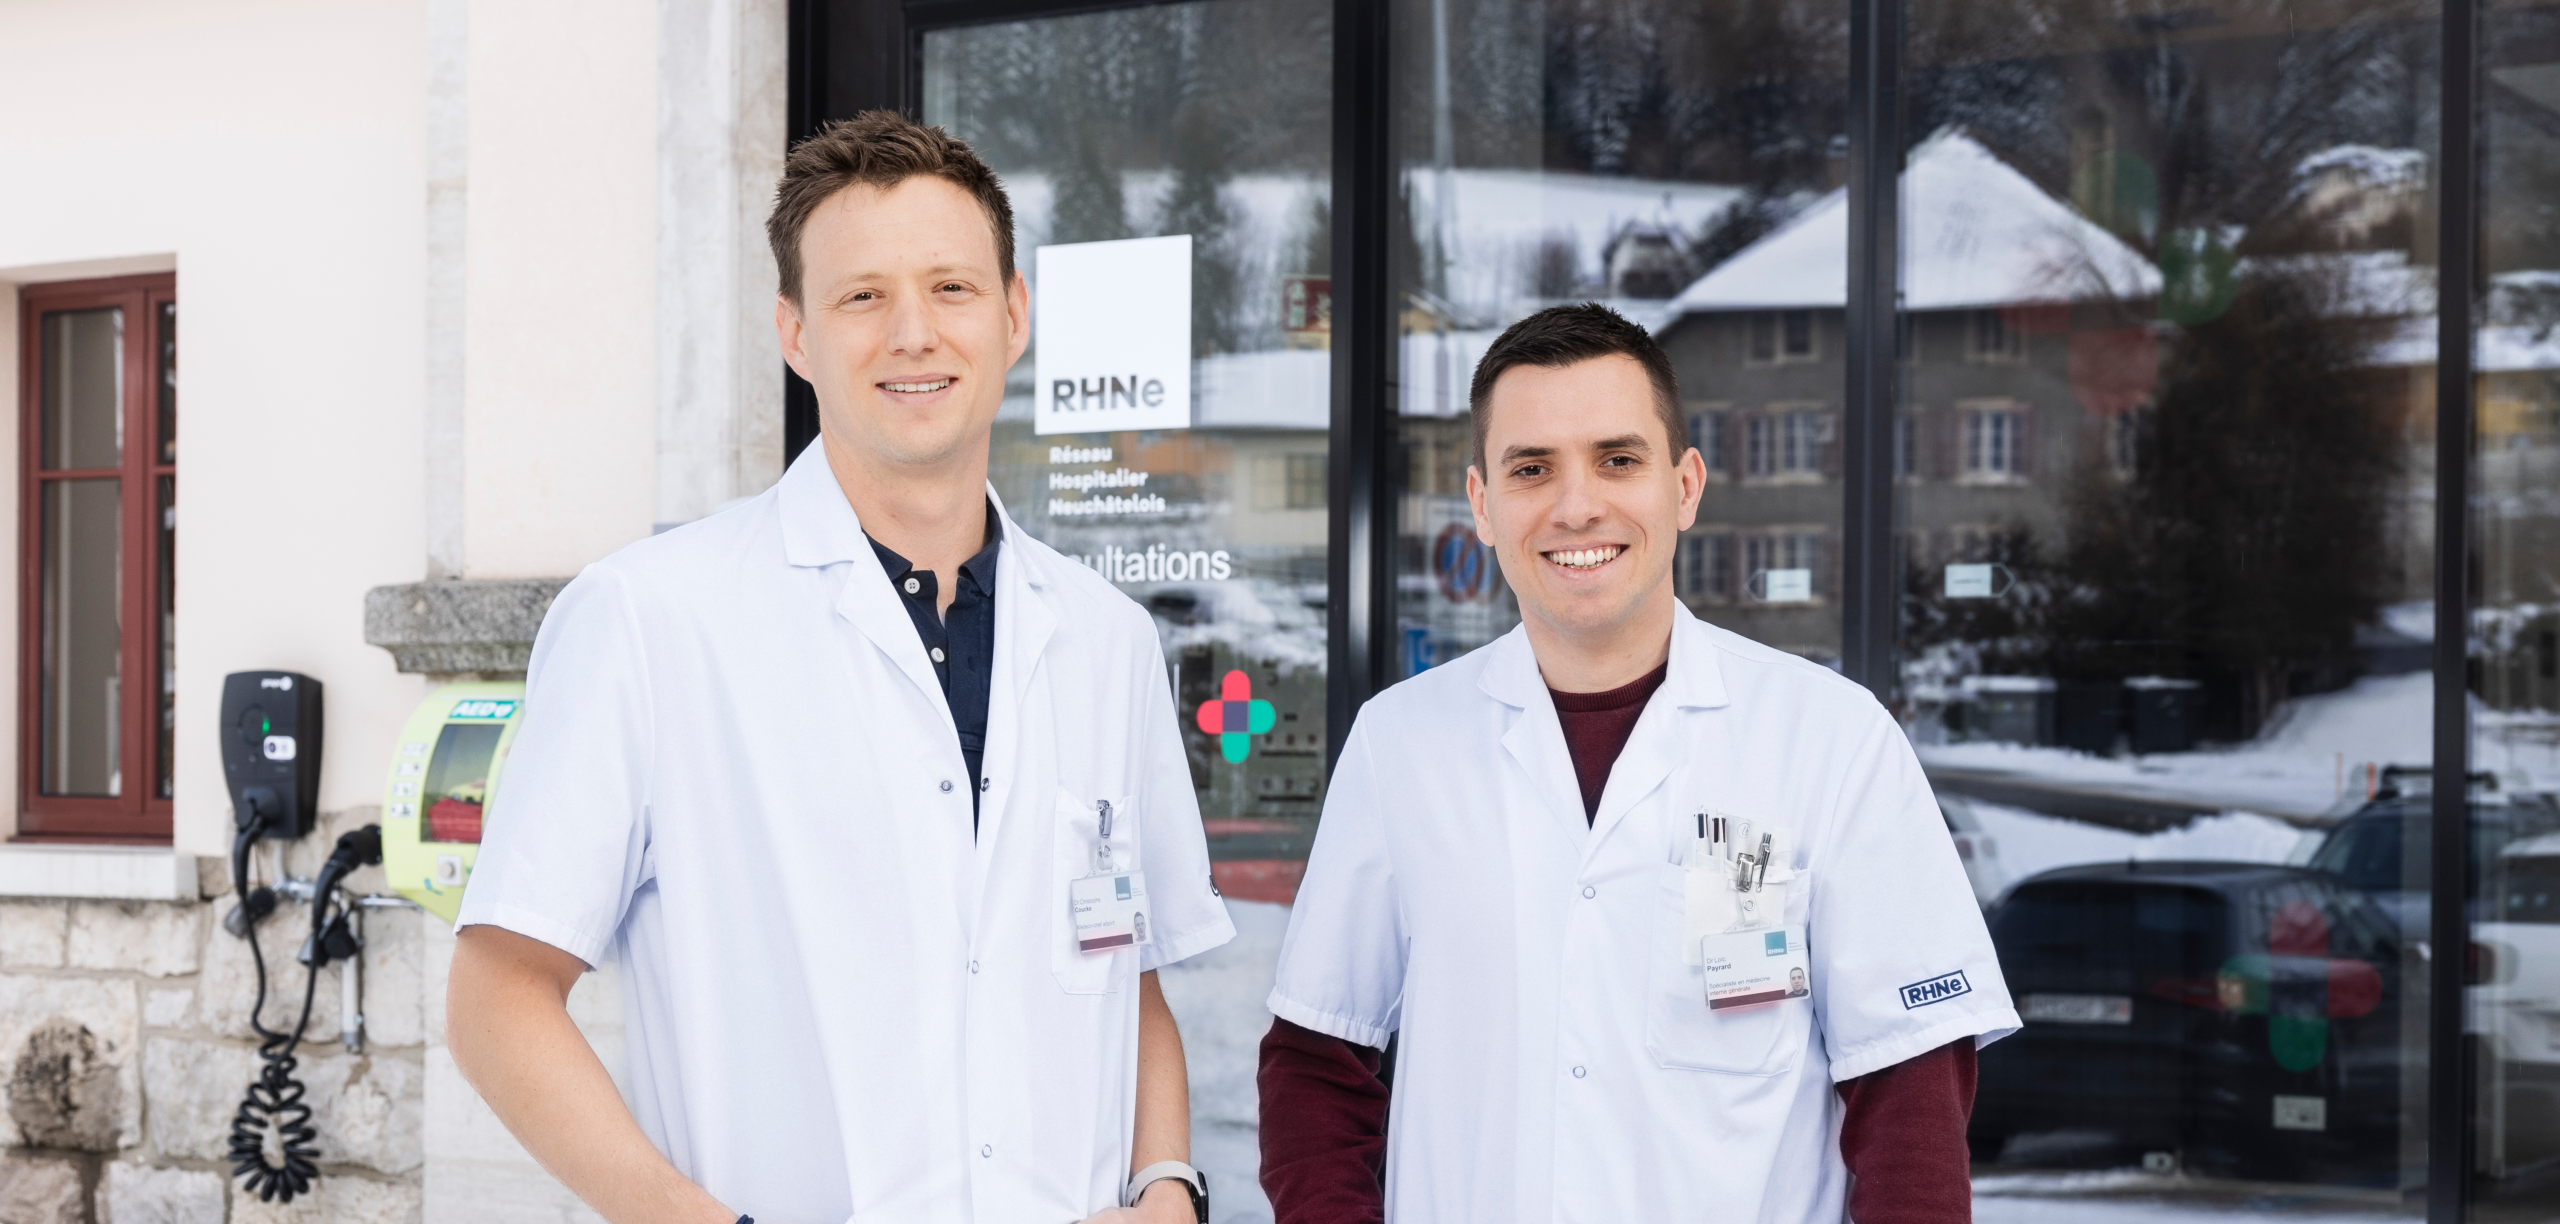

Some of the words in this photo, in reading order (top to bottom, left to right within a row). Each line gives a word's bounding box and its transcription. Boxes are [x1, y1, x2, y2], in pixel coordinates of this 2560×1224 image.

[1052, 374, 1165, 412] RHNe
[1049, 444, 1113, 464] Réseau
[1049, 467, 1149, 494] Hospitalier
[1048, 493, 1166, 516] Neuchâtelois
[451, 701, 497, 717] AED
[1707, 963, 1731, 972] Payrard
[1709, 981, 1737, 989] Spécialiste
[1745, 976, 1771, 984] médecine
[1728, 985, 1751, 995] générale
[1907, 978, 1962, 1004] RHNe
